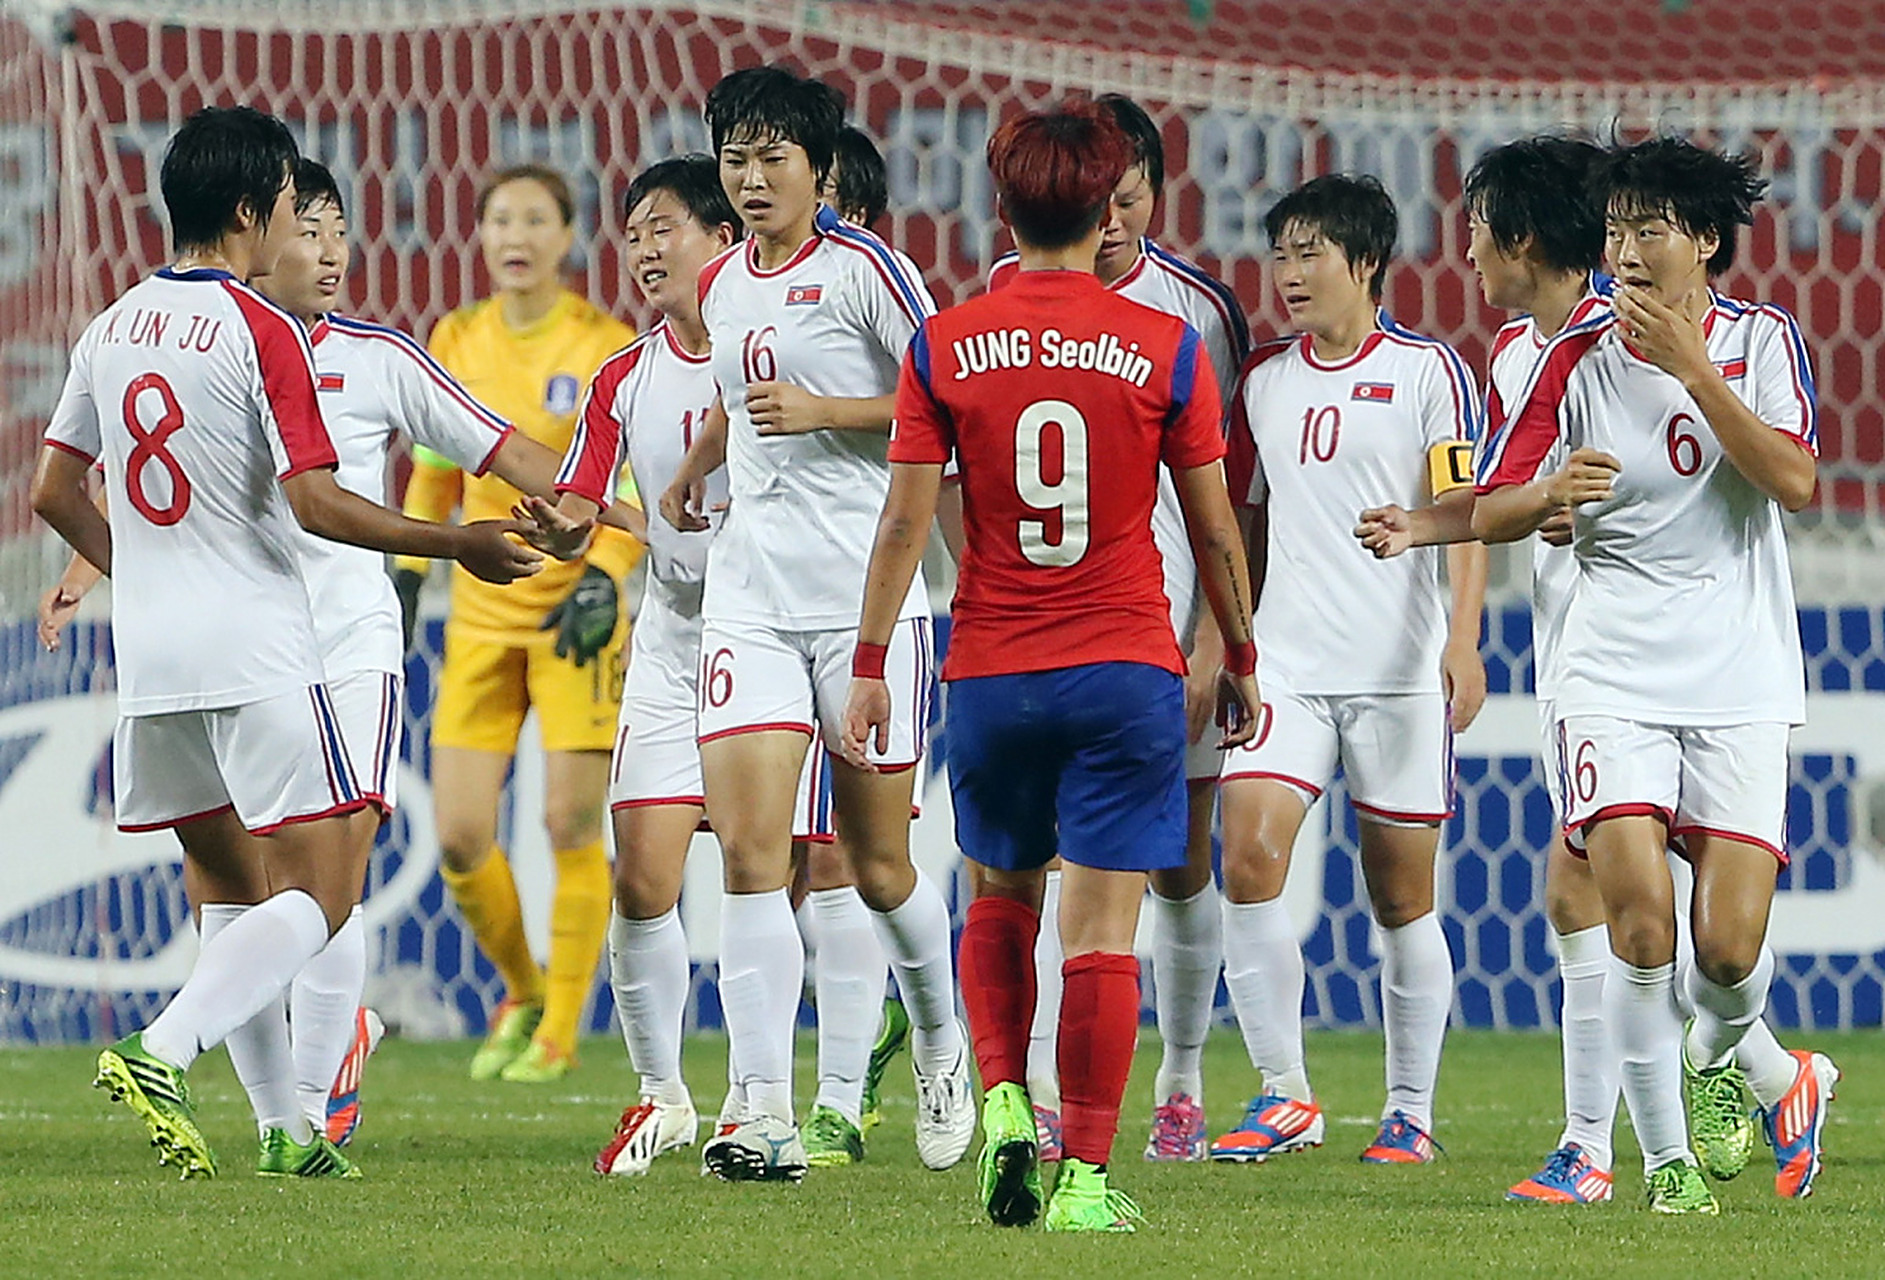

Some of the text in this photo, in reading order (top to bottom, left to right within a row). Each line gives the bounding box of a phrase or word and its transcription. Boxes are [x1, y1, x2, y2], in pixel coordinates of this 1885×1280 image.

[129, 309, 171, 347] UN
[179, 315, 221, 352] JU
[742, 325, 778, 384] 16
[952, 328, 1153, 388] JUNG Seolbin
[122, 372, 191, 527] 8
[1299, 405, 1341, 465] 10
[1667, 413, 1702, 477] 6
[1015, 400, 1089, 567] 9
[702, 647, 734, 712] 16
[1575, 740, 1597, 803] 6
